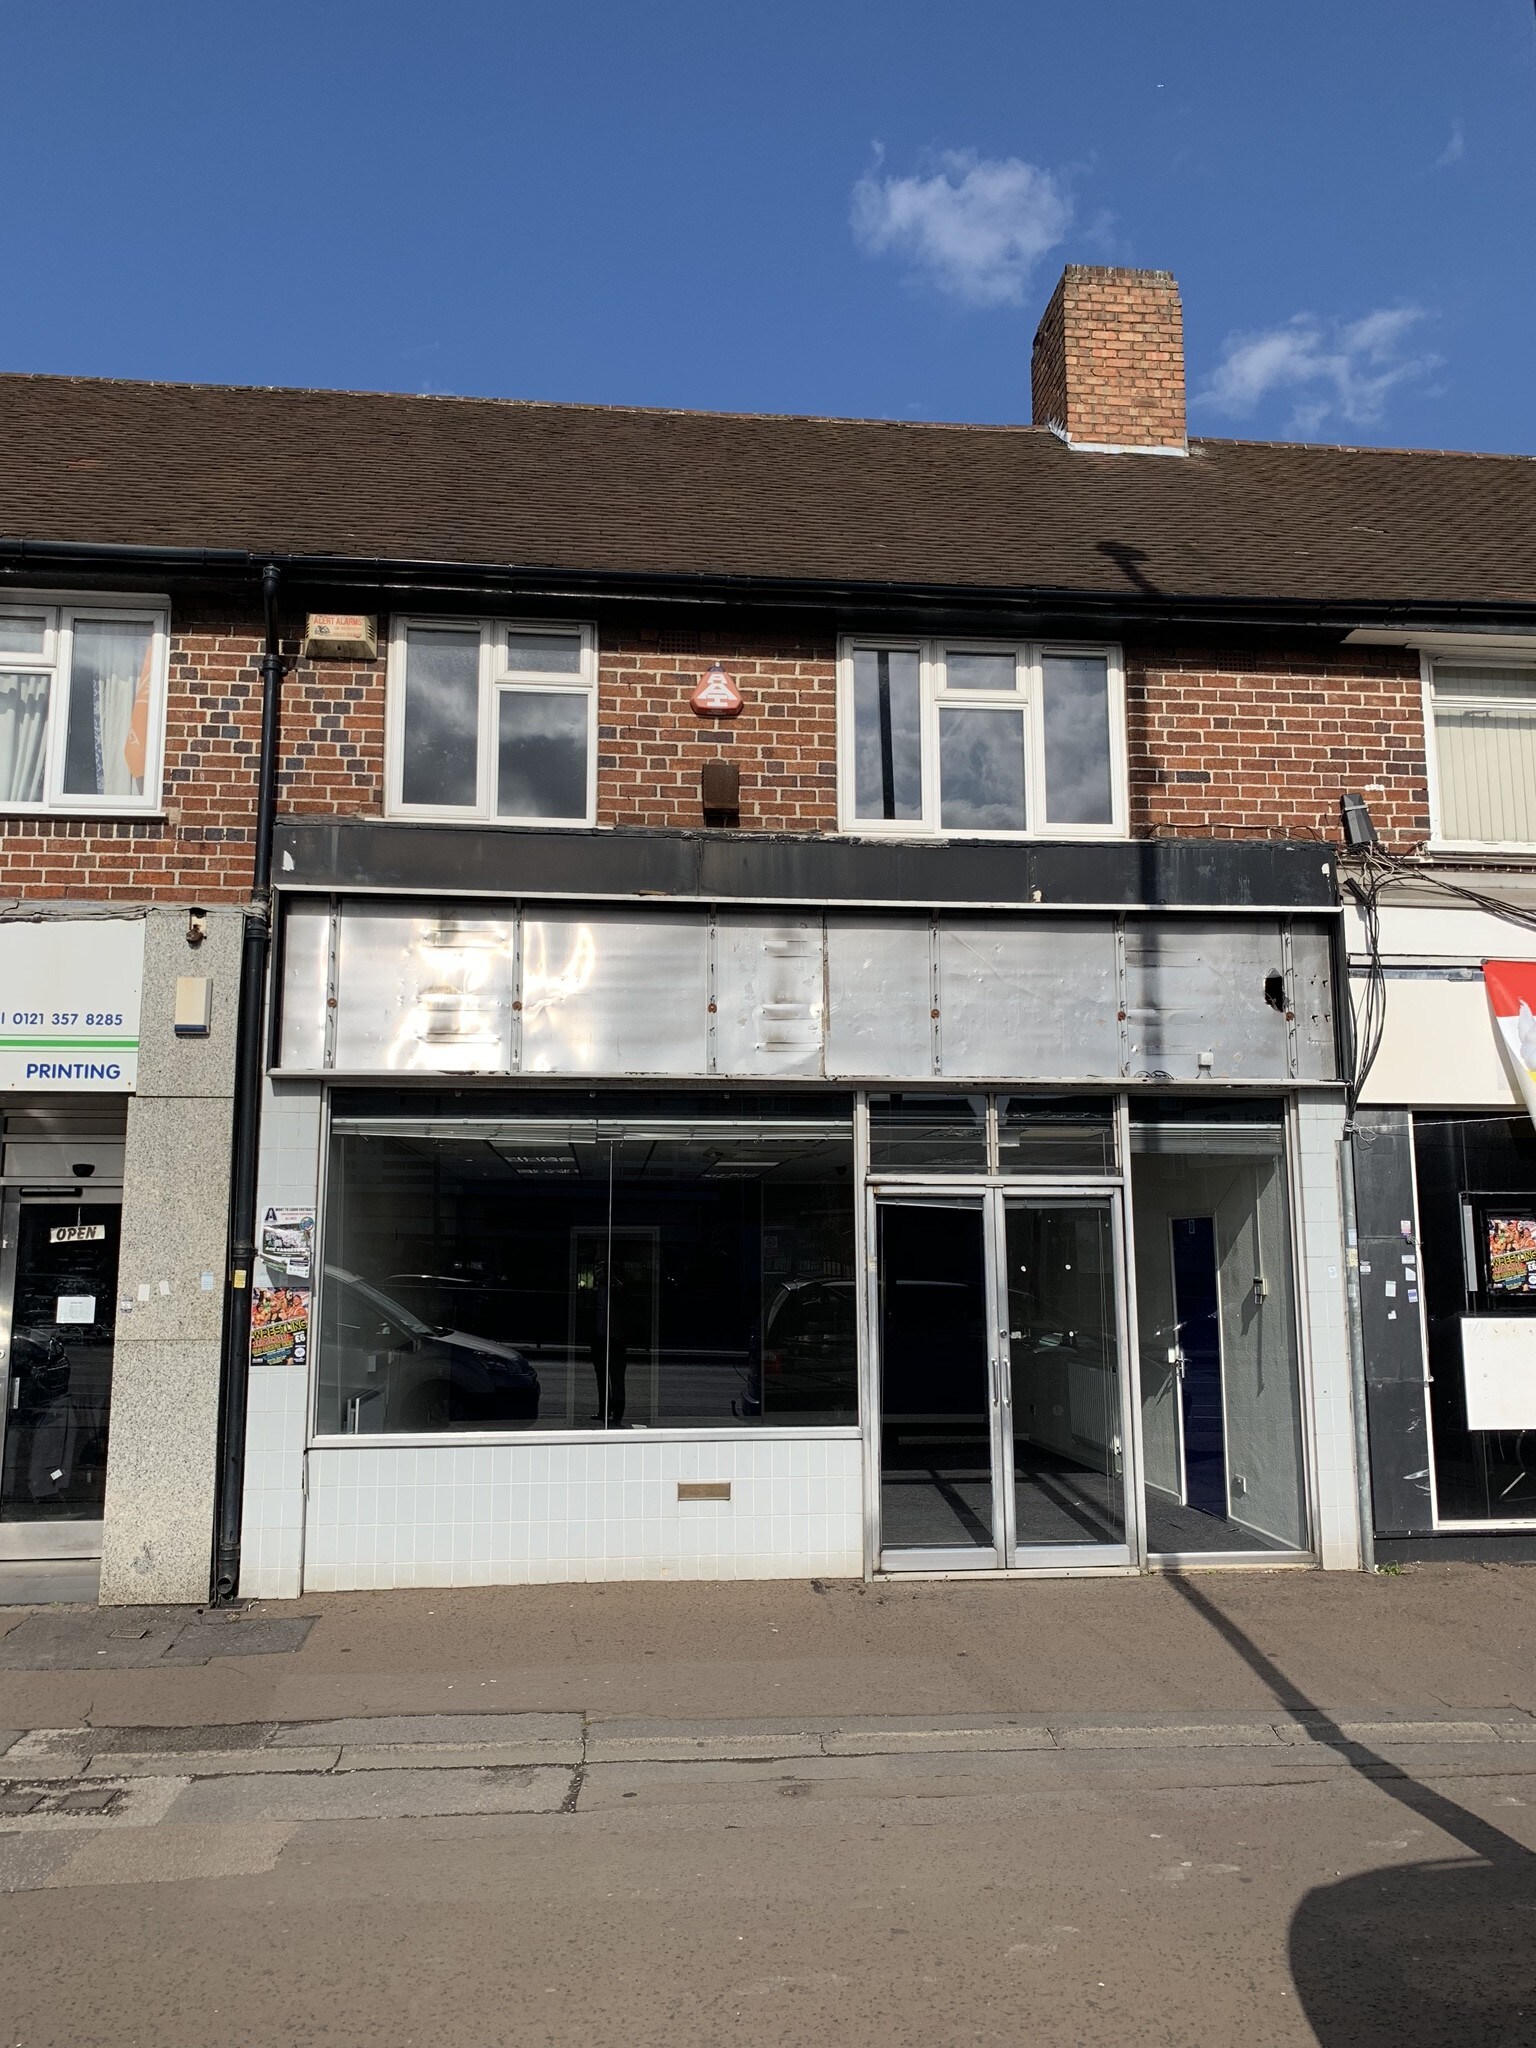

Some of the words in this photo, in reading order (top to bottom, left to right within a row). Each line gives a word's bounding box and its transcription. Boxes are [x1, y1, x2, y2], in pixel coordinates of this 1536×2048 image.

[313, 616, 334, 625] ALERT
[336, 617, 363, 626] ALARMS
[12, 1012, 44, 1025] 0121
[51, 1013, 78, 1025] 357
[85, 1013, 123, 1026] 8285
[26, 1063, 121, 1080] PRINTING
[56, 1226, 97, 1241] OPEN
[252, 1319, 307, 1340] WRESTLING
